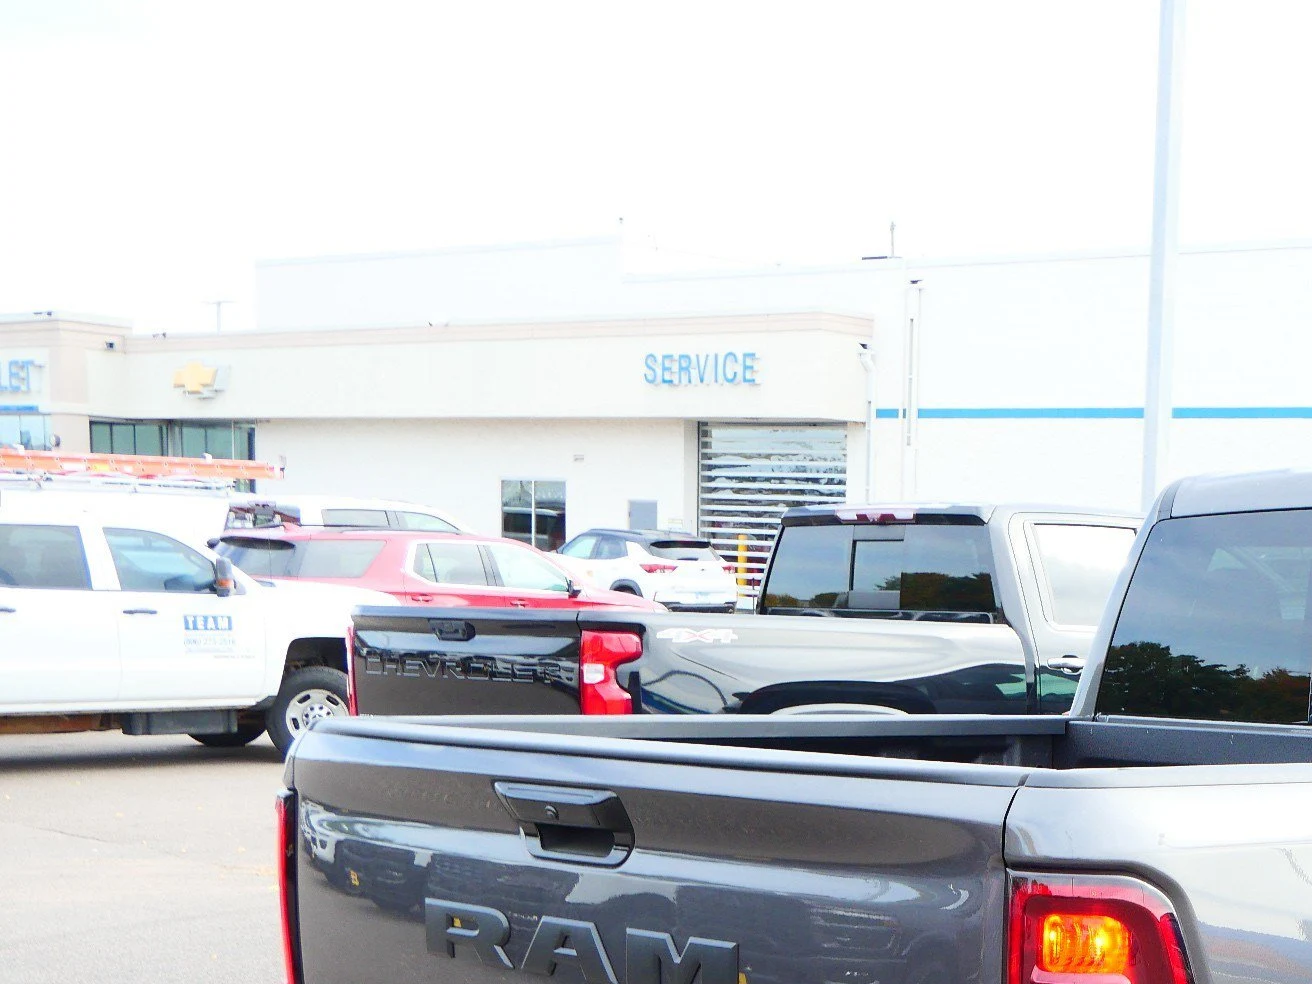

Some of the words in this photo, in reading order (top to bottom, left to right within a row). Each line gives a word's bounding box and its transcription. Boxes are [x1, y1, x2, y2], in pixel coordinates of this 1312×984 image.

[643, 351, 757, 385] SERVICE
[184, 615, 231, 630] TEAM
[366, 652, 561, 684] CHEVROLET
